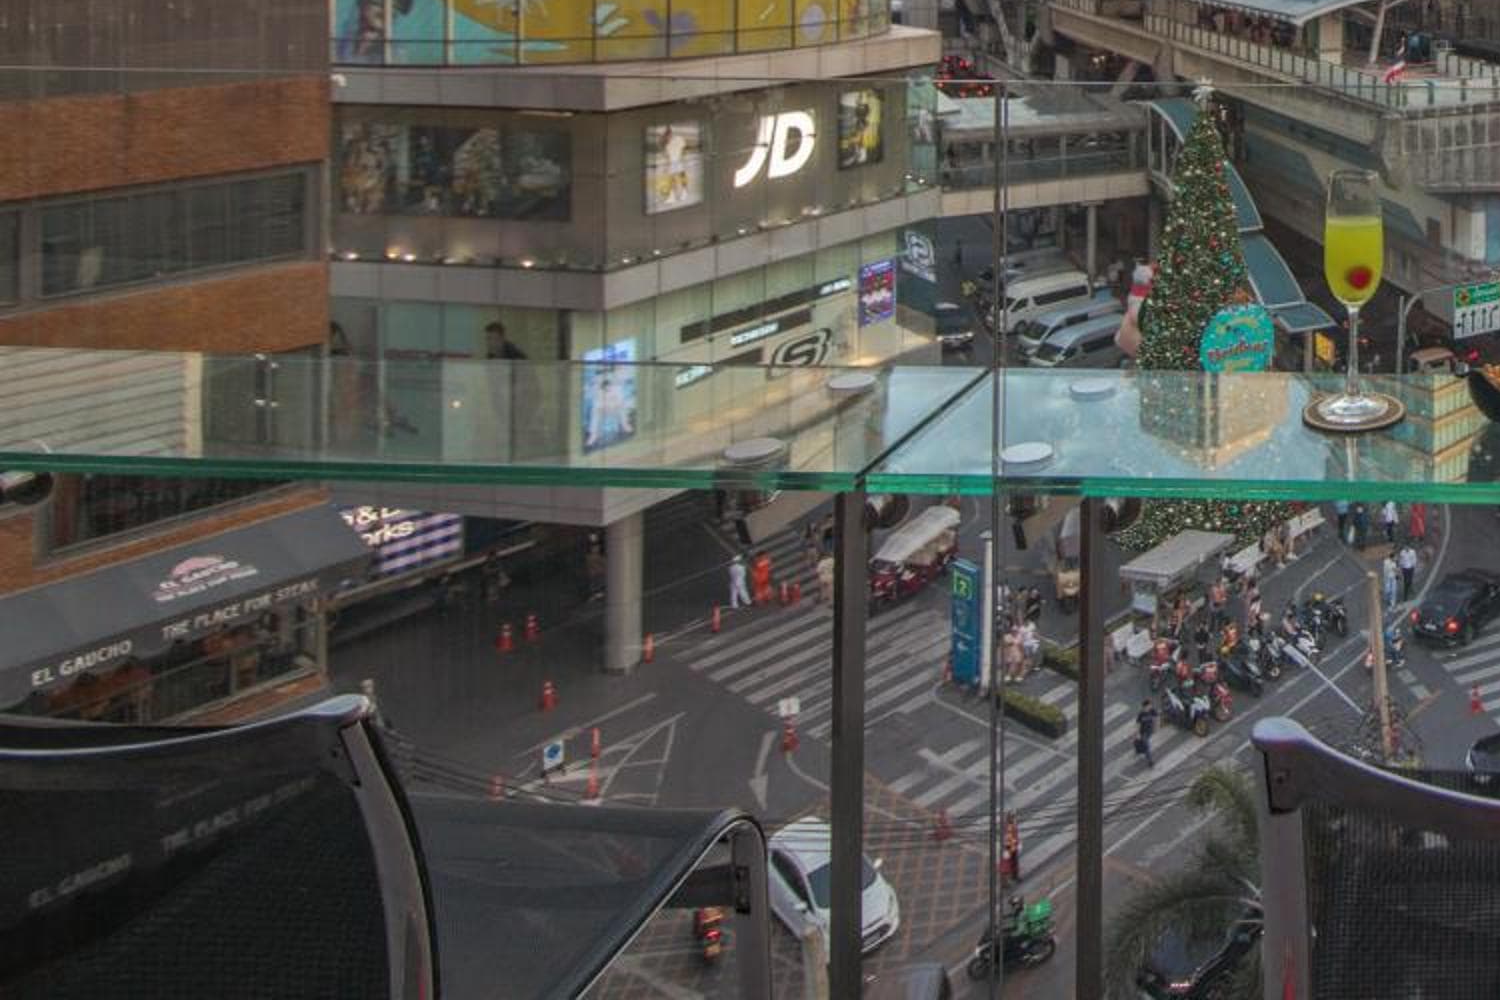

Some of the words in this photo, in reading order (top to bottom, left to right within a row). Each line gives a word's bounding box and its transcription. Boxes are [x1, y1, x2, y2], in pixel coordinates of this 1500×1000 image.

[733, 111, 815, 188] JD
[31, 667, 55, 686] EL
[59, 640, 132, 676] GAUCHO
[162, 619, 190, 641] THE
[194, 602, 241, 629] PLACE
